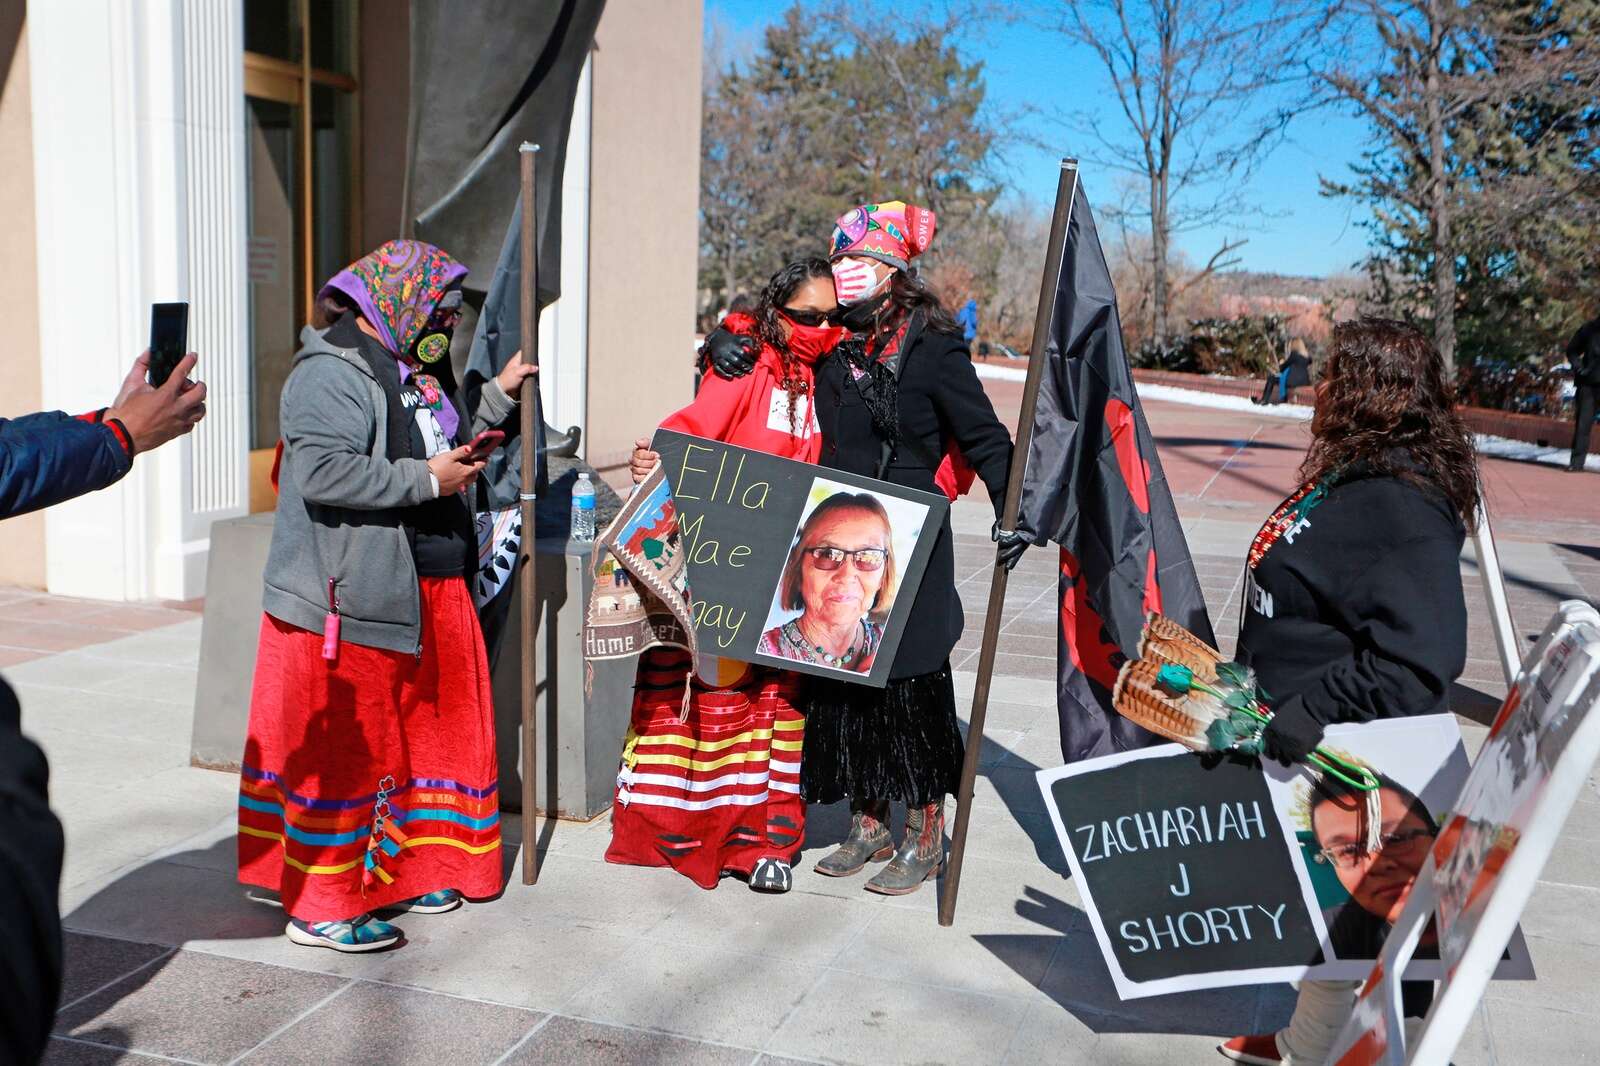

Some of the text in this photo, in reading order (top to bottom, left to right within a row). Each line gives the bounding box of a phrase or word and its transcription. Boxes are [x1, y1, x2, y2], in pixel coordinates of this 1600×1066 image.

[675, 443, 770, 509] Ella
[677, 512, 752, 567] Mae
[586, 628, 634, 655] Home
[692, 600, 746, 648] gay
[1075, 801, 1266, 863] ZACHARIAH
[1170, 863, 1190, 897] J
[1120, 903, 1286, 953] SHORTY
